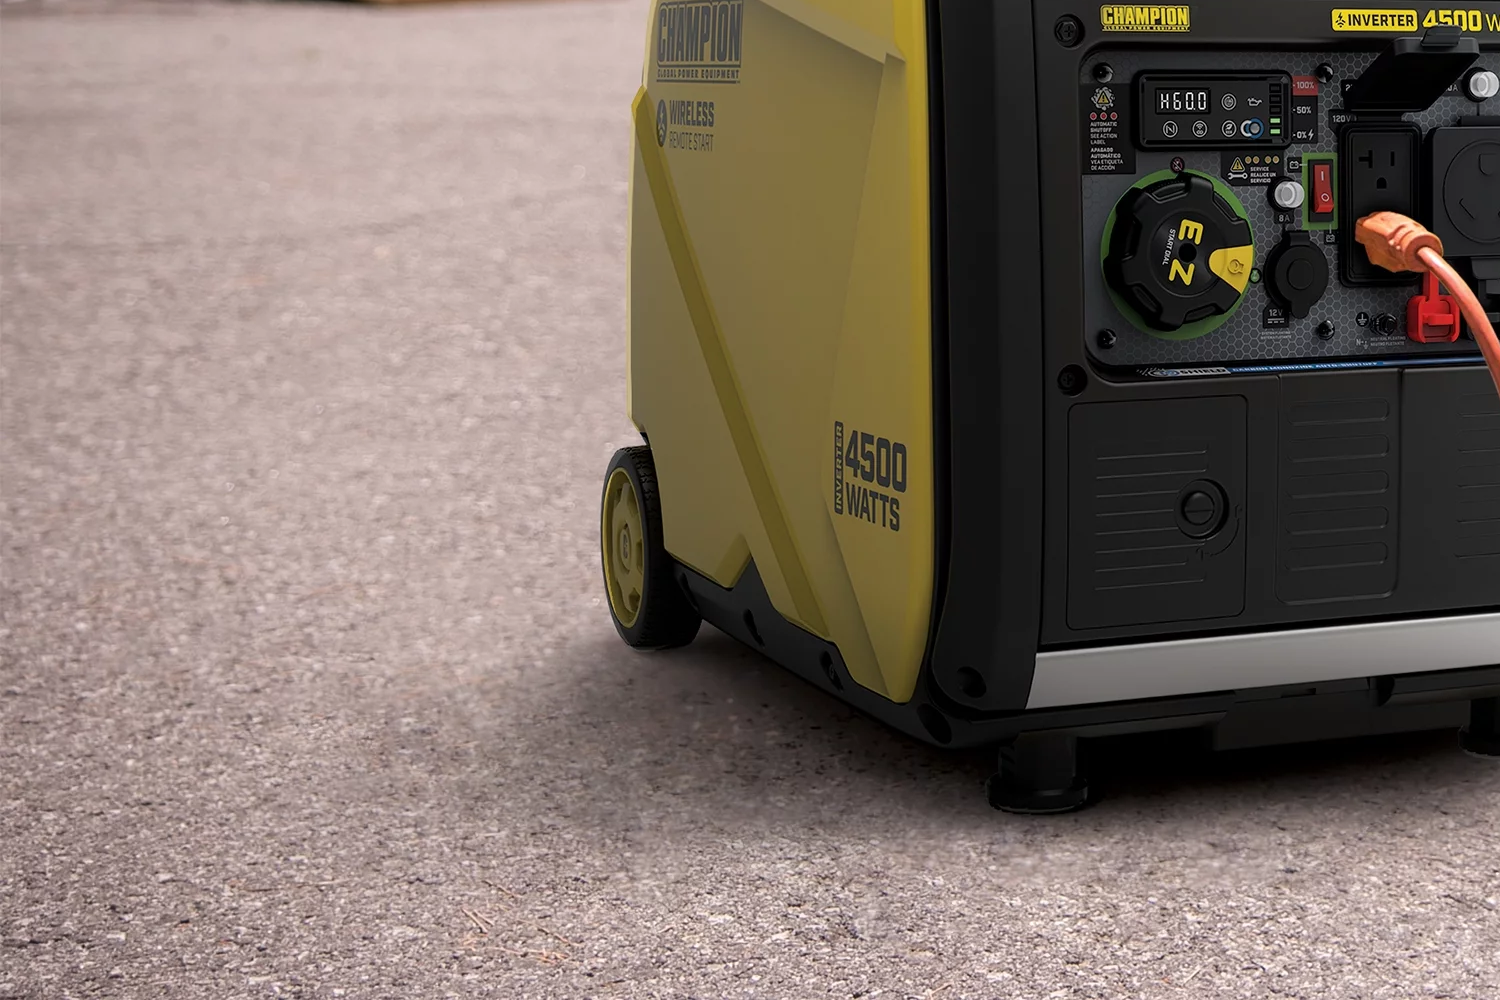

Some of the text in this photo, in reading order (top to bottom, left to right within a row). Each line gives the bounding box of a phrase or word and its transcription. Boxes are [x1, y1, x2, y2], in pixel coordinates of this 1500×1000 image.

[657, 1, 742, 63] CHAMPION
[1102, 6, 1188, 26] CHAMPION
[1348, 13, 1414, 27] INVERTER
[1422, 9, 1482, 32] 4500
[657, 69, 740, 80] GLOBAL POWER EQUIPMENT
[669, 100, 715, 128] WIRELESS
[669, 131, 714, 152] REMOTE START
[1162, 228, 1176, 266] START DIAL
[835, 424, 843, 510] INVERTER
[845, 430, 907, 493] 4500
[845, 482, 900, 532] WATTS
